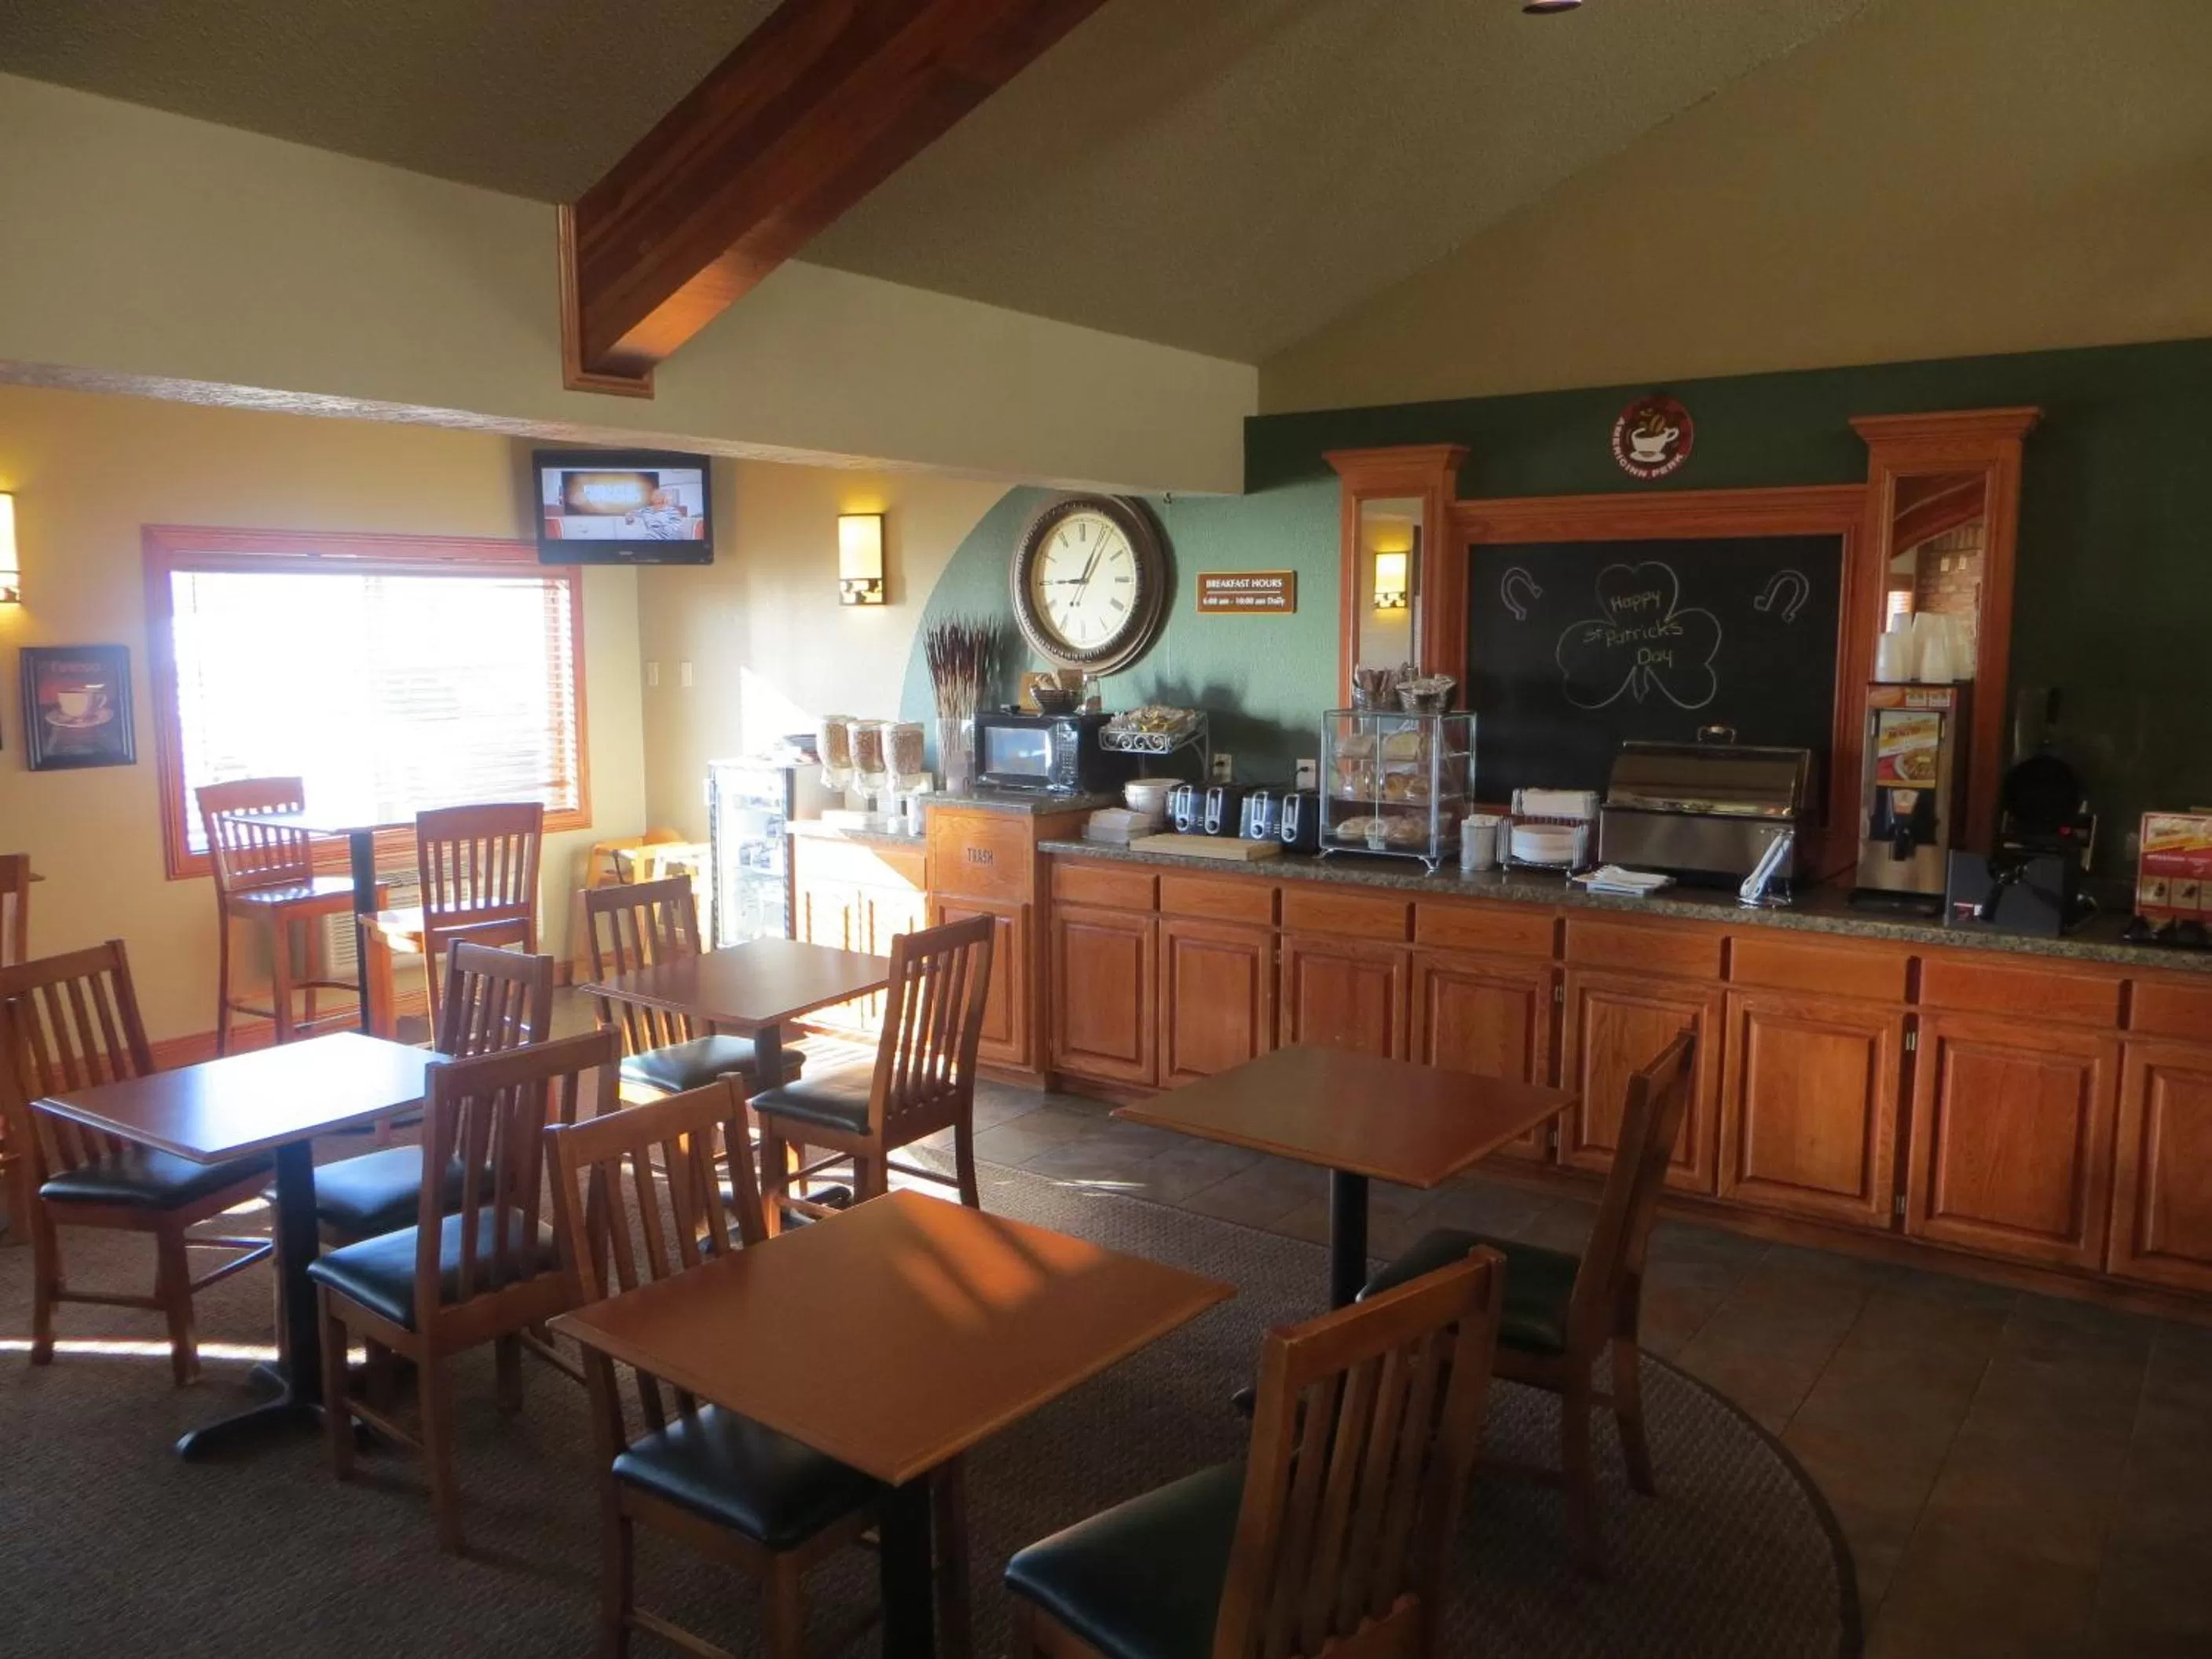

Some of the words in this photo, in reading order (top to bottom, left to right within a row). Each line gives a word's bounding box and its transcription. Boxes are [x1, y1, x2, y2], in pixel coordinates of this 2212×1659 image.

[1206, 579, 1250, 588] BREAKFAST
[1251, 578, 1282, 588] HOURS
[1610, 589, 1662, 612] Happy
[1636, 647, 1673, 668] Day
[967, 848, 994, 866] TRASH
